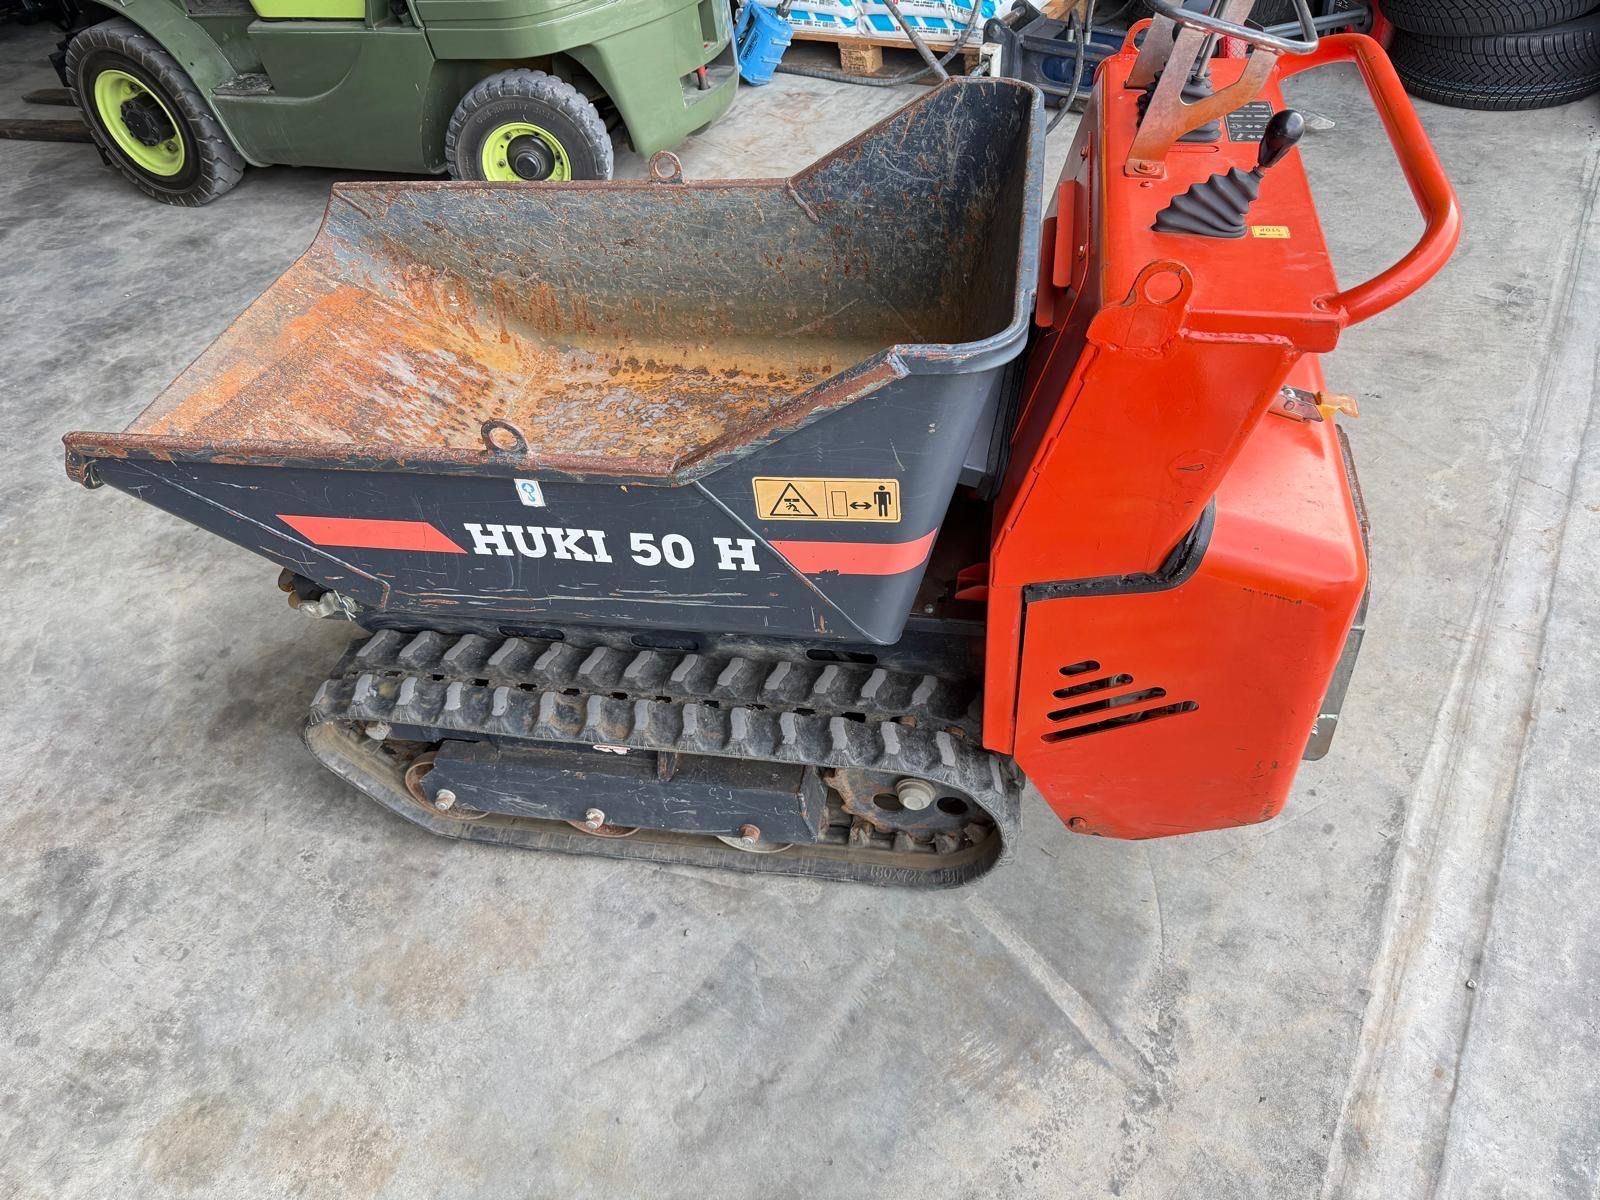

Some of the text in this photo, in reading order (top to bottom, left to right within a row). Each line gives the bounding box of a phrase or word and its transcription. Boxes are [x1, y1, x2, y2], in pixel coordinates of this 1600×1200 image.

[463, 522, 761, 572] HUKI 50 H
